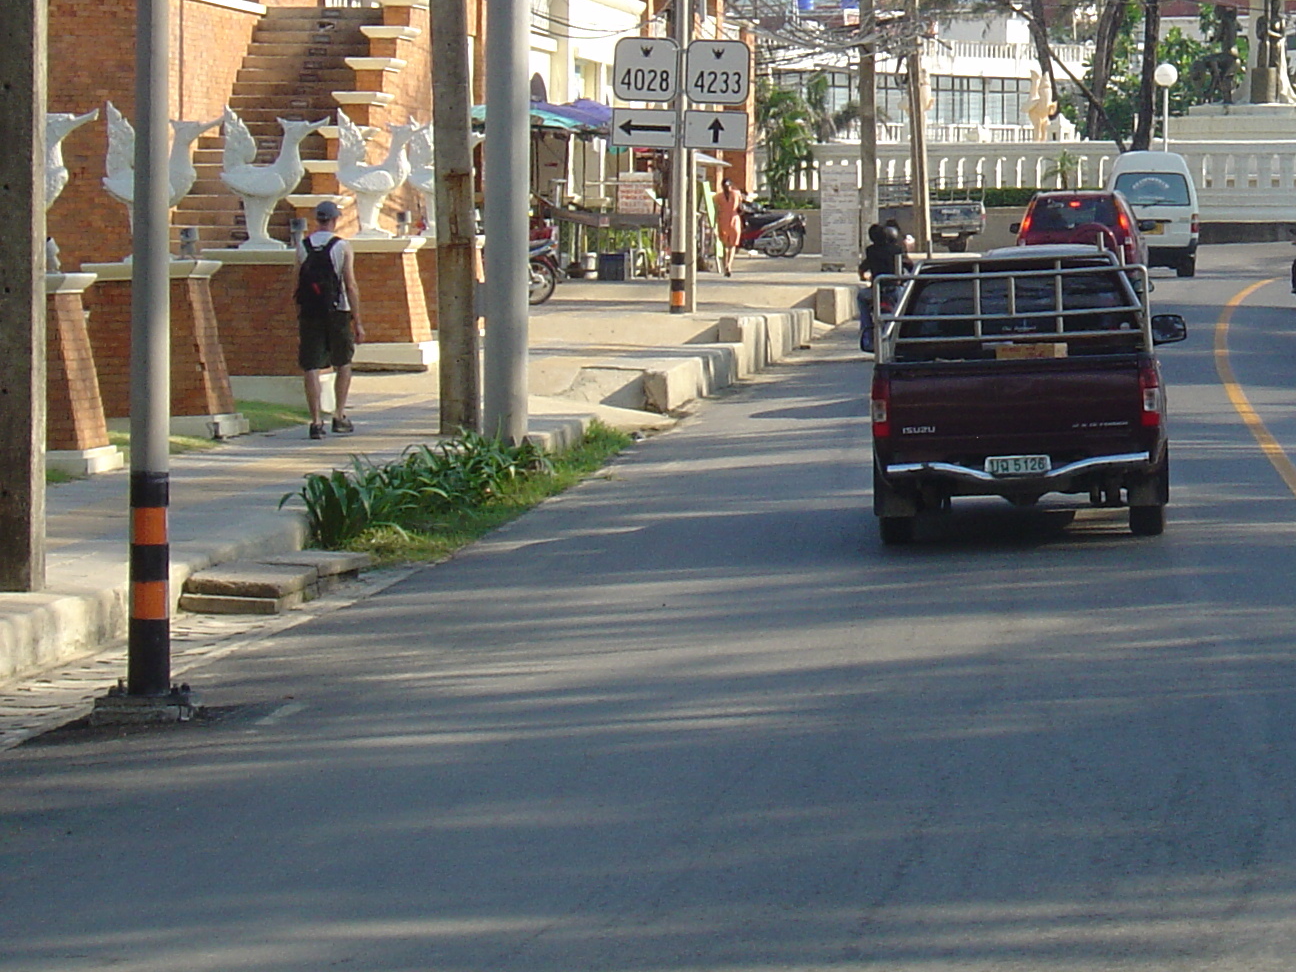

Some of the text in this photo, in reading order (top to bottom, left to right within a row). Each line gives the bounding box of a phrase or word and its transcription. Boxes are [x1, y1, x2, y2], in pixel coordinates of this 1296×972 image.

[620, 68, 670, 92] 4028
[694, 70, 741, 94] 4233
[902, 426, 936, 434] ISUZU
